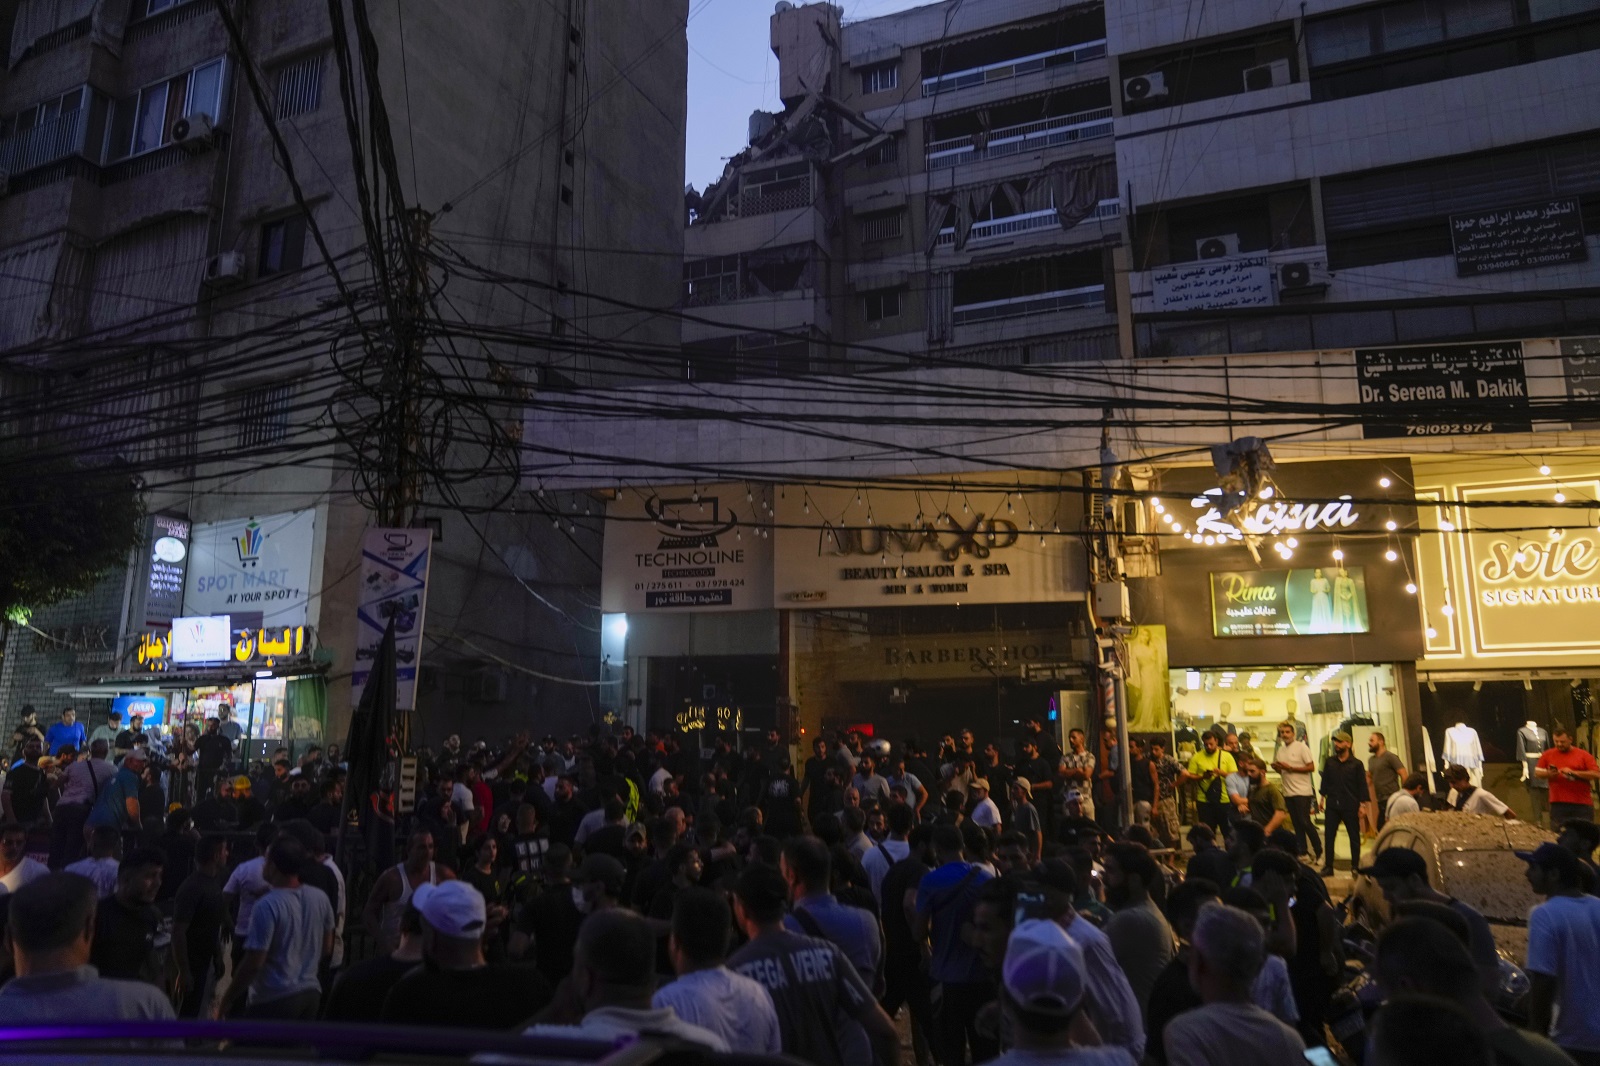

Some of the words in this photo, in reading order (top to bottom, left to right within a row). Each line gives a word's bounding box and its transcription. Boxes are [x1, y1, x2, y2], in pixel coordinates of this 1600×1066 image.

[1514, 208, 1538, 221] محمد
[1540, 201, 1575, 219] الدكتور
[1209, 264, 1231, 276] موسى
[1234, 256, 1267, 273] الدكتور
[1171, 283, 1191, 292] العين
[1213, 288, 1234, 298] العين
[1237, 285, 1263, 293] جراحة
[1195, 292, 1211, 300] عند
[1361, 384, 1384, 403] Dr.
[1389, 383, 1446, 402] Serena
[1449, 380, 1470, 399] M.
[1476, 378, 1524, 398] Dakik
[635, 549, 744, 567] TECHNOLINE
[842, 567, 898, 580] BEAUTY
[906, 565, 955, 578] SALON
[962, 564, 975, 576] &
[983, 563, 1010, 576] SPA
[197, 574, 238, 593] SPOT
[243, 569, 289, 588] MART
[226, 591, 237, 604] AT
[240, 591, 261, 603] YOUR
[264, 589, 292, 601] SPOT
[884, 585, 906, 595] MEN
[931, 583, 968, 593] WOMEN
[1221, 574, 1277, 604] Rima
